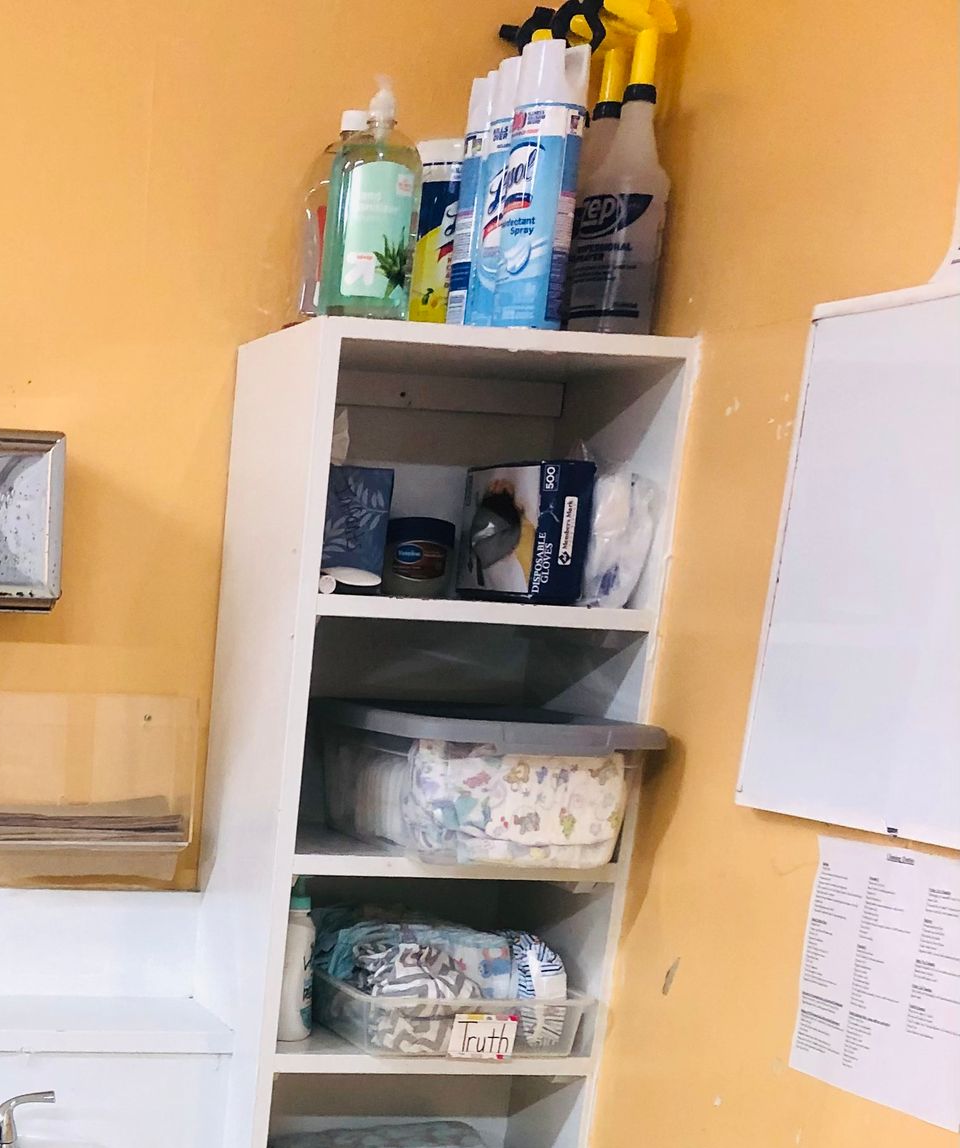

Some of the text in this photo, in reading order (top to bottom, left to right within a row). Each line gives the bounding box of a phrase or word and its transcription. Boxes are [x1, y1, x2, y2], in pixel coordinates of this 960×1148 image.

[510, 227, 534, 236] Spray
[545, 466, 556, 490] 500
[531, 532, 547, 594] DISPOSABLE
[540, 542, 554, 584] GLOVES
[458, 1021, 509, 1053] Truth
